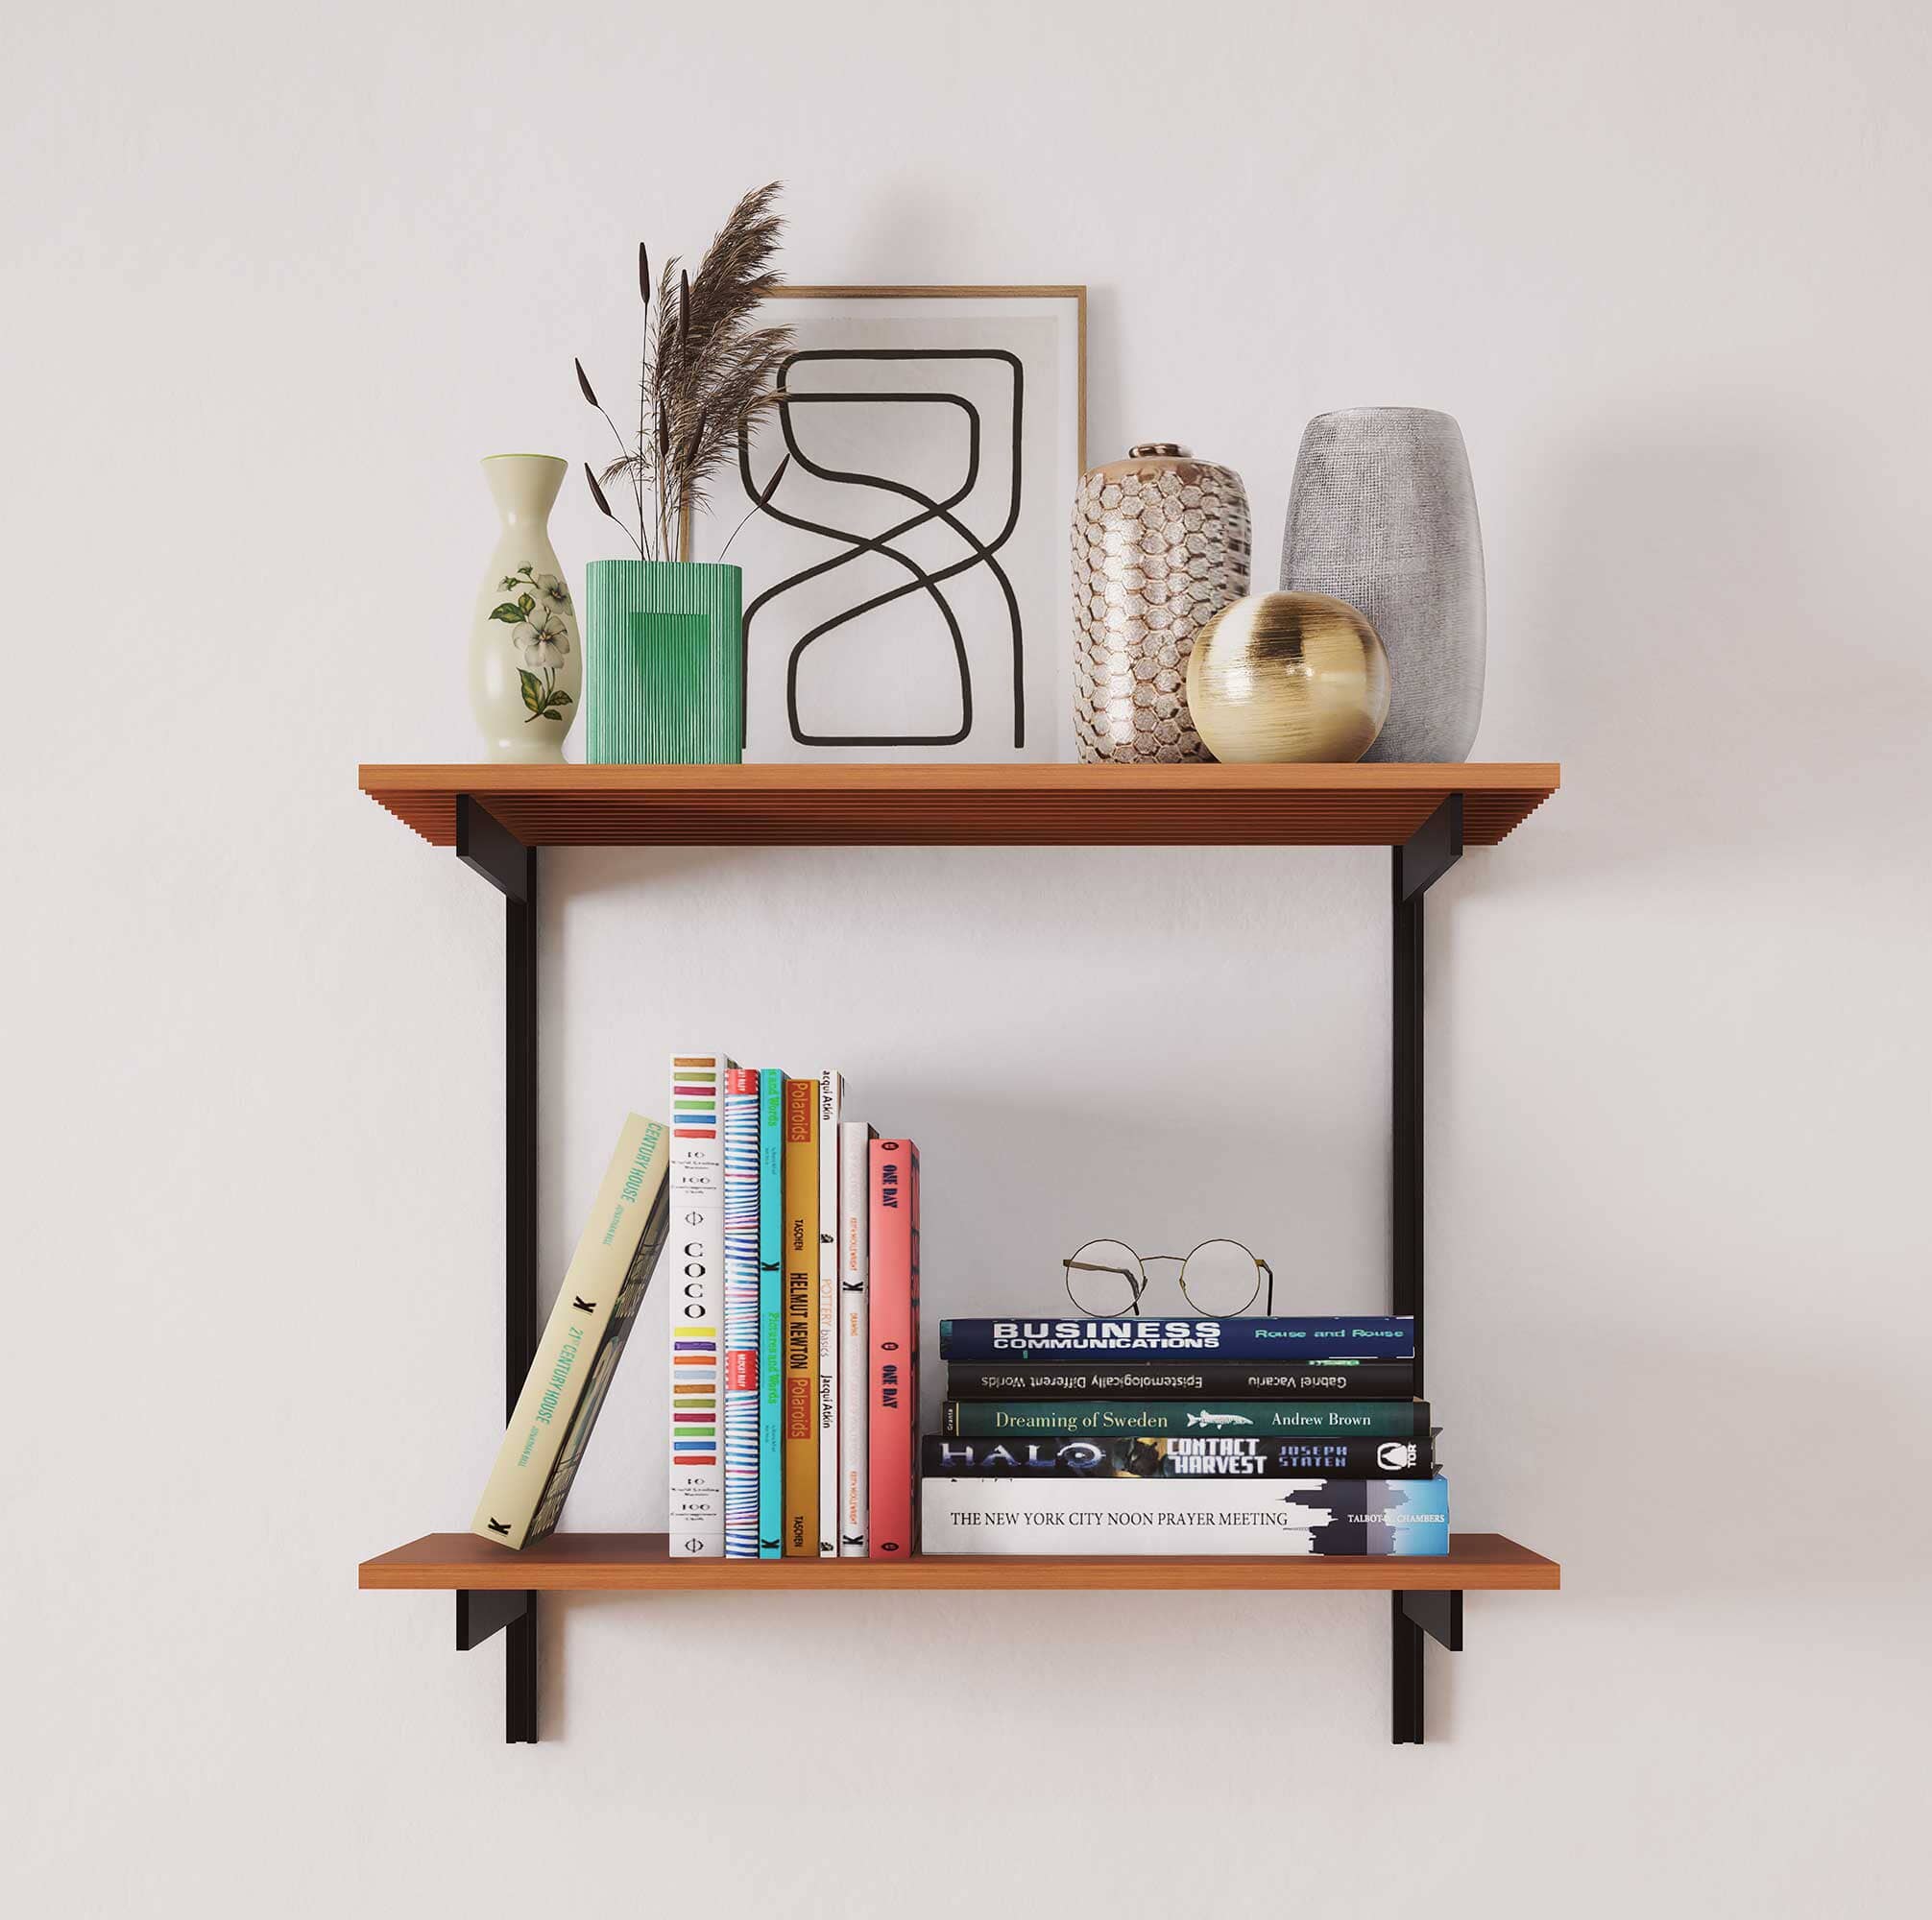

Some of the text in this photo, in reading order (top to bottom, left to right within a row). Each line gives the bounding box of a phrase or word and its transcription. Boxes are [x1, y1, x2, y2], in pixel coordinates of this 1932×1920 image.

[768, 1096, 781, 1127] Words
[791, 1082, 808, 1141] Polaroids
[822, 1095, 833, 1120] Atkin
[633, 1121, 663, 1168] CENTURY
[620, 1166, 645, 1203] HOUSE
[882, 1164, 898, 1209] ONE DAY
[794, 1219, 804, 1251] TASCHEN
[761, 1261, 780, 1271] K
[843, 1282, 864, 1291] K
[572, 1296, 596, 1314] K
[790, 1273, 808, 1369] HELMUT NEWTON
[820, 1279, 833, 1357] POTTERY basics
[993, 1322, 1221, 1338] BUSINESS
[1254, 1329, 1405, 1338] Rouse and Rouse
[993, 1338, 1220, 1349] COMMUNICATIONS
[548, 1343, 577, 1390] CENTURY
[768, 1311, 781, 1404] Pictures and Words
[882, 1364, 898, 1409] ONE DAY
[981, 1374, 1203, 1389] Epistemologically Different Worlds
[1248, 1376, 1347, 1388] Gabriel Vacariu
[535, 1388, 560, 1425] HOUSE
[791, 1380, 808, 1437] Polaroids
[820, 1374, 833, 1428] Jacqui Atkin
[996, 1411, 1168, 1431] Dreaming of Sweden
[1271, 1412, 1371, 1427] Andrew Brown
[939, 1442, 1106, 1469] HALO
[1166, 1438, 1260, 1456] CONTACT
[1278, 1446, 1348, 1456] JOSEPH
[1407, 1443, 1417, 1469] TOR
[1168, 1455, 1268, 1475] HARVEST
[1278, 1456, 1347, 1468] STATEN
[488, 1517, 512, 1536] K
[950, 1512, 1289, 1526] THE NEW YORK CITY NOON PRAYER MEETING
[1397, 1514, 1445, 1524] CHAMBERS
[794, 1515, 804, 1548] TASCHEN
[843, 1535, 864, 1546] K
[761, 1539, 780, 1548] K
